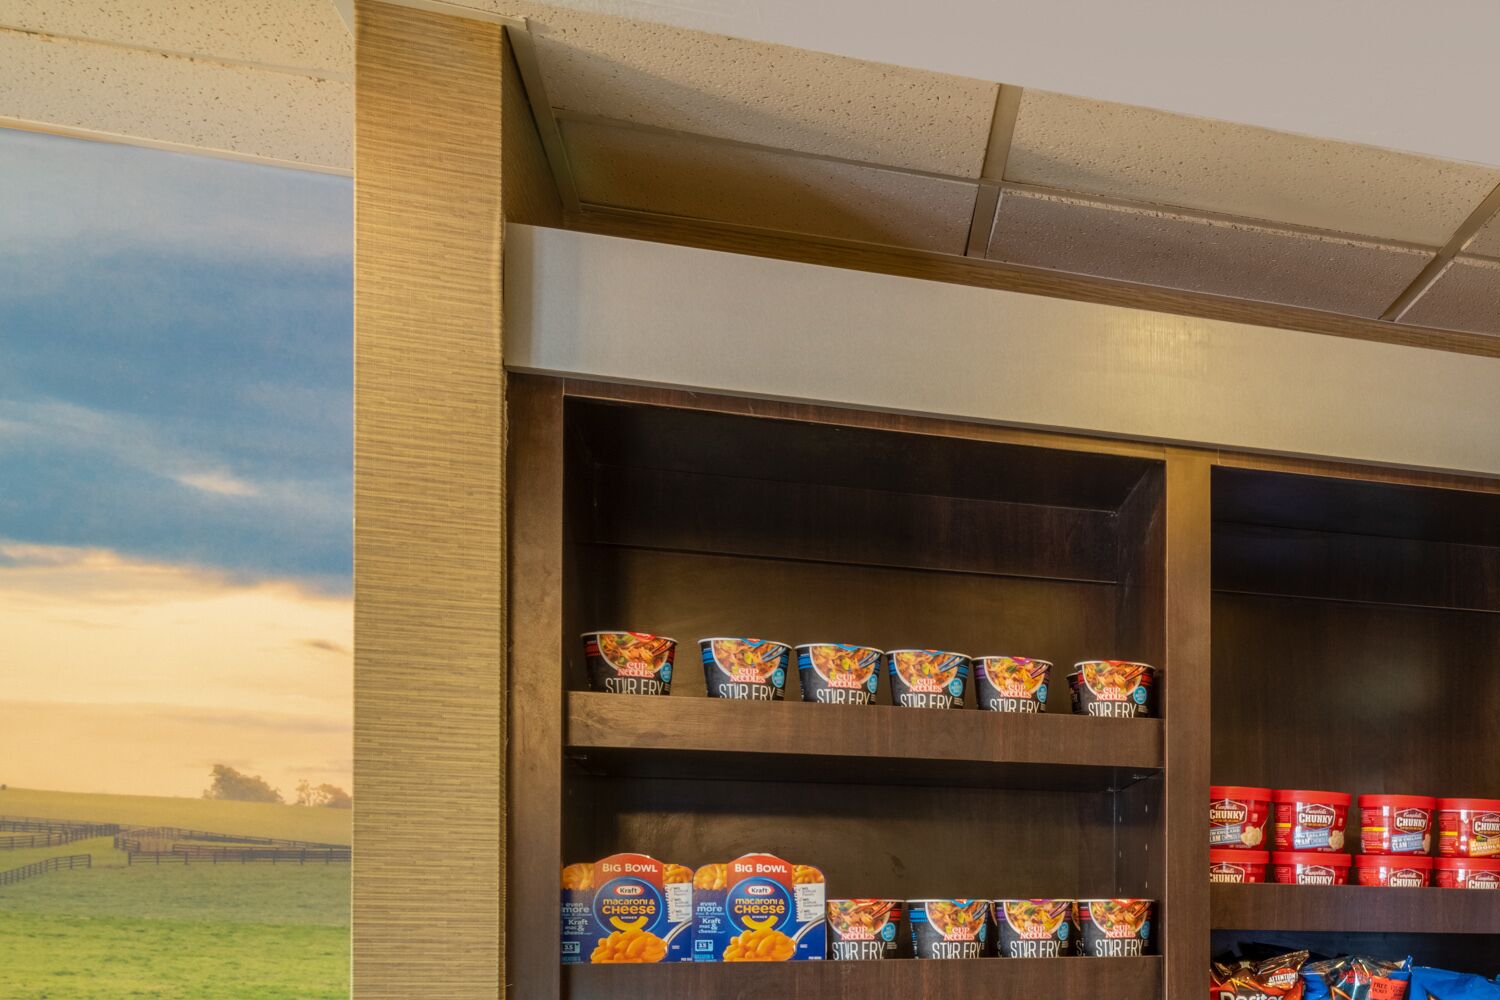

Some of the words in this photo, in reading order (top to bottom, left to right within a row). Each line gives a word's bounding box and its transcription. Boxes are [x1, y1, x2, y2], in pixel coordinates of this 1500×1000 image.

[626, 662, 648, 671] CUP
[616, 667, 655, 678] NOODLES
[1210, 810, 1244, 821] CHUNKY
[1298, 813, 1333, 825] CHUNKY
[1396, 817, 1426, 828] CHUNKY
[602, 864, 622, 873] BIG
[625, 864, 658, 873] BOWL
[734, 864, 753, 873] BIG
[756, 864, 788, 873] BOWL
[1298, 875, 1332, 885] CHUNKY
[1390, 877, 1421, 887] CHUNKY
[1468, 879, 1499, 889] CHUNKY
[697, 905, 723, 913] more
